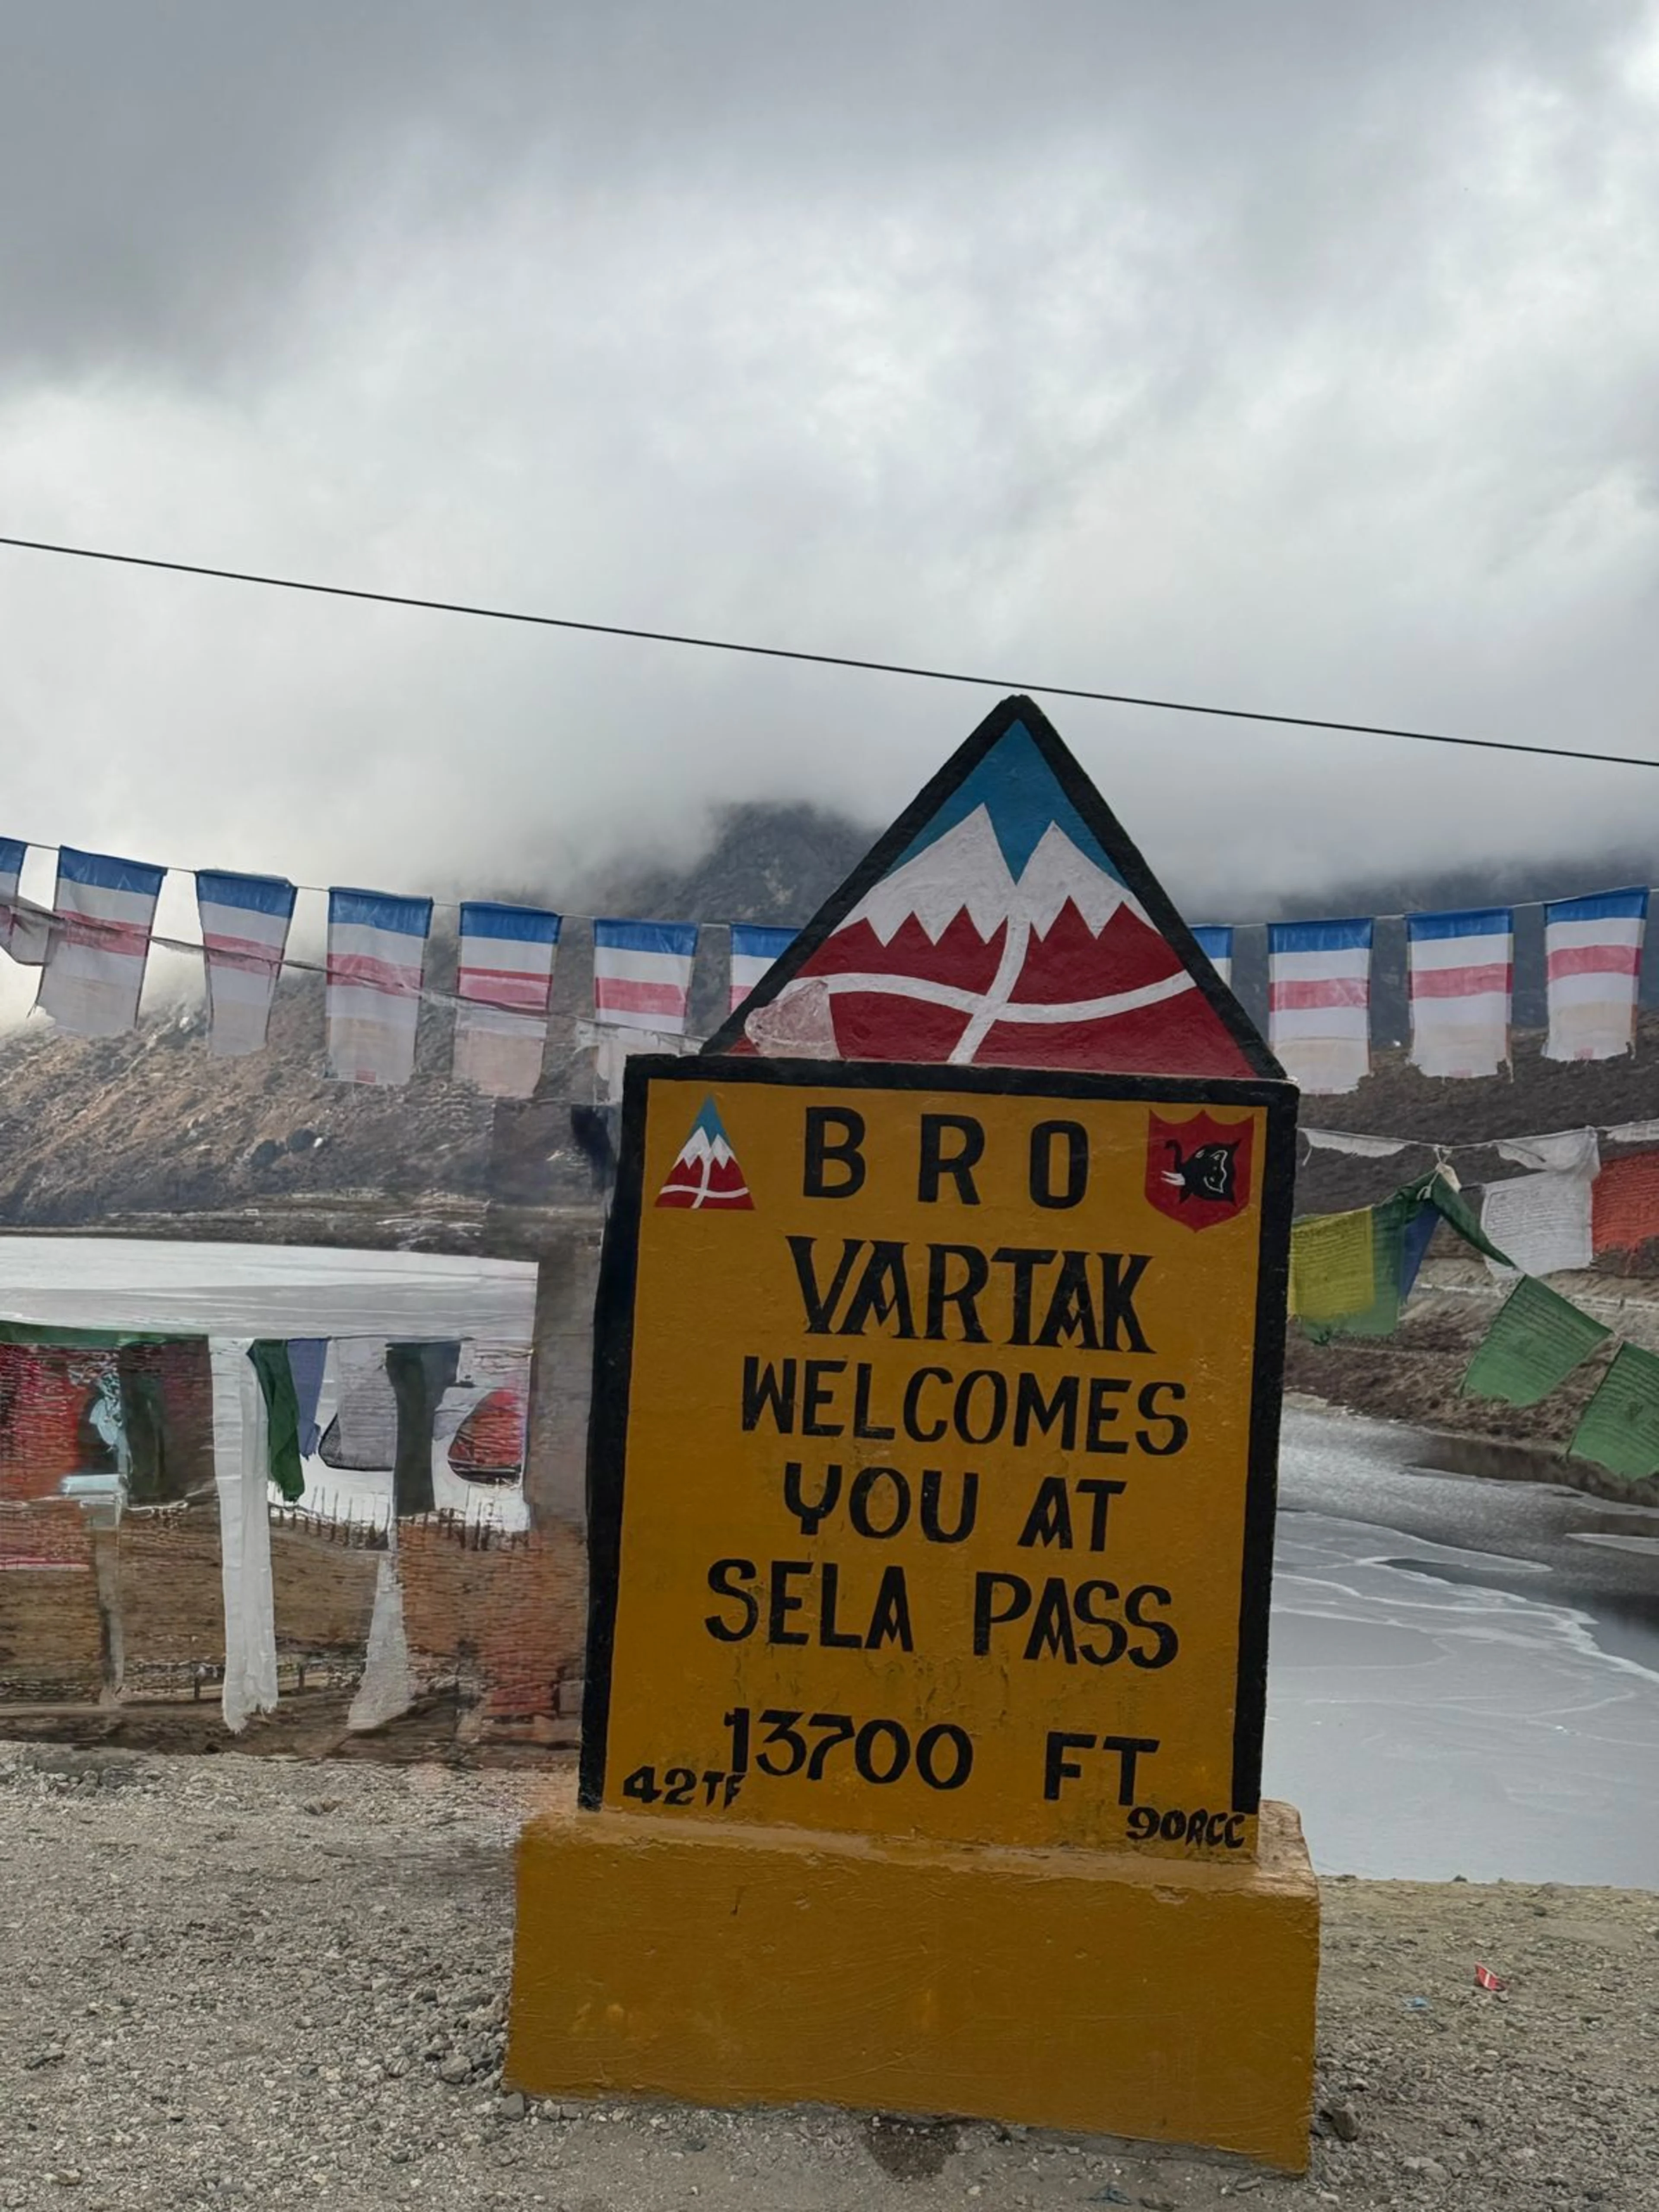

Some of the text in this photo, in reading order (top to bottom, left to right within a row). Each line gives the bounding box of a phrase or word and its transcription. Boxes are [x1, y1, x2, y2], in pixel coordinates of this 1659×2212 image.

[785, 1236, 1156, 1354] VARTAK
[742, 1356, 1189, 1456] WELCOMES
[784, 1462, 1126, 1551] YOU AT
[705, 1559, 1179, 1669] SELA PASS
[623, 1766, 746, 1809] 42TF
[724, 1707, 1160, 1806] 13700 FT
[1126, 1807, 1246, 1849] 90RCC
